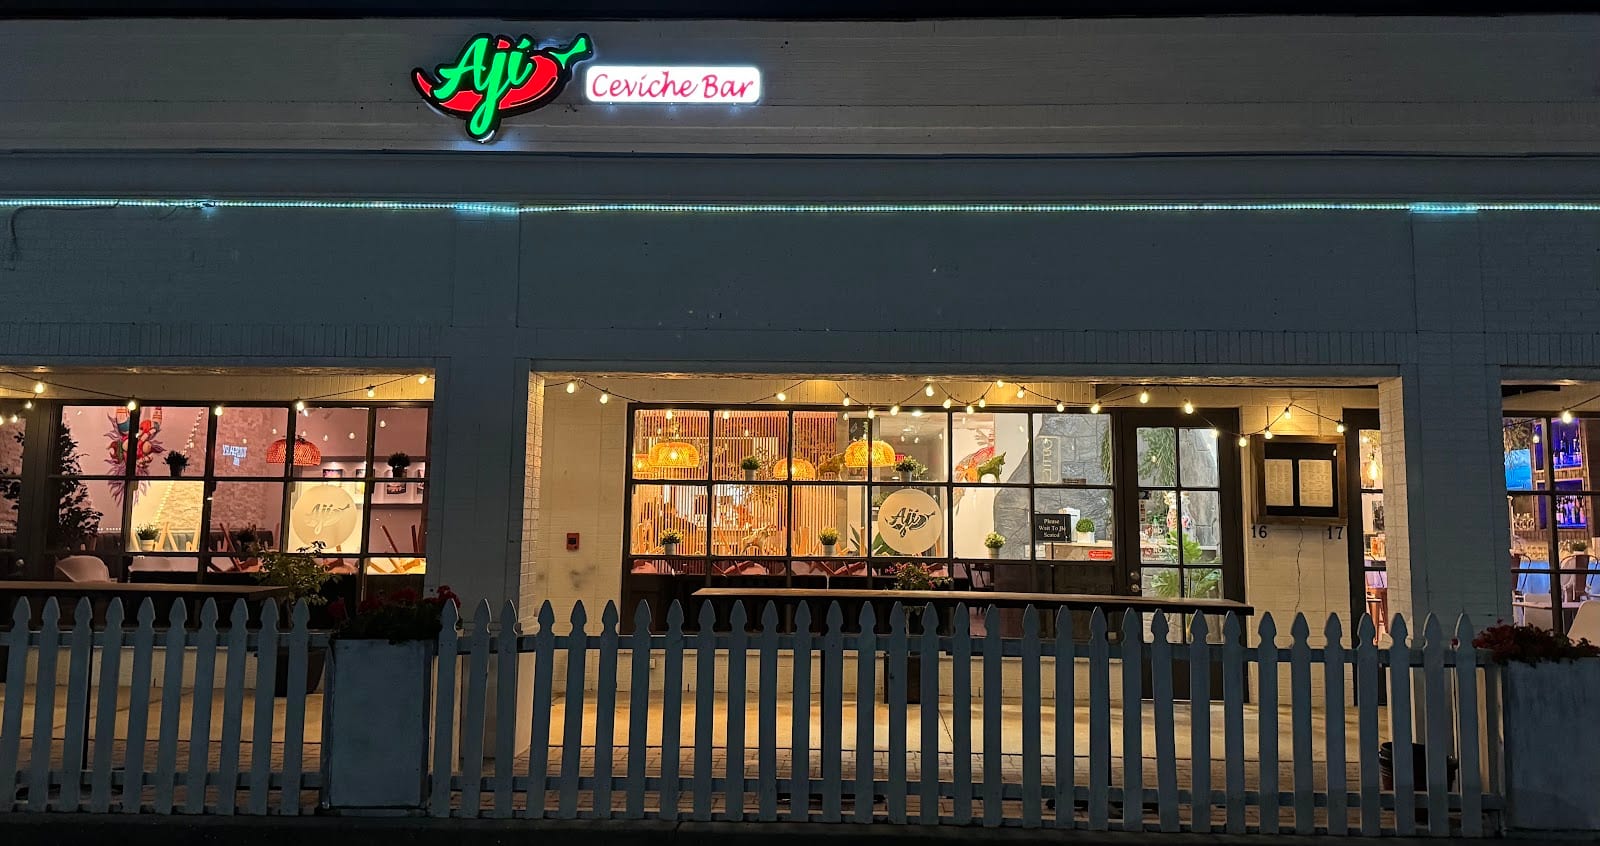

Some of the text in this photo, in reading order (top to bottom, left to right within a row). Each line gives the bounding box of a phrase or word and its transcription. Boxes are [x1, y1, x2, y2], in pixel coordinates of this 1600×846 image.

[701, 74, 755, 98] Bar
[1251, 525, 1344, 540] 16 17
